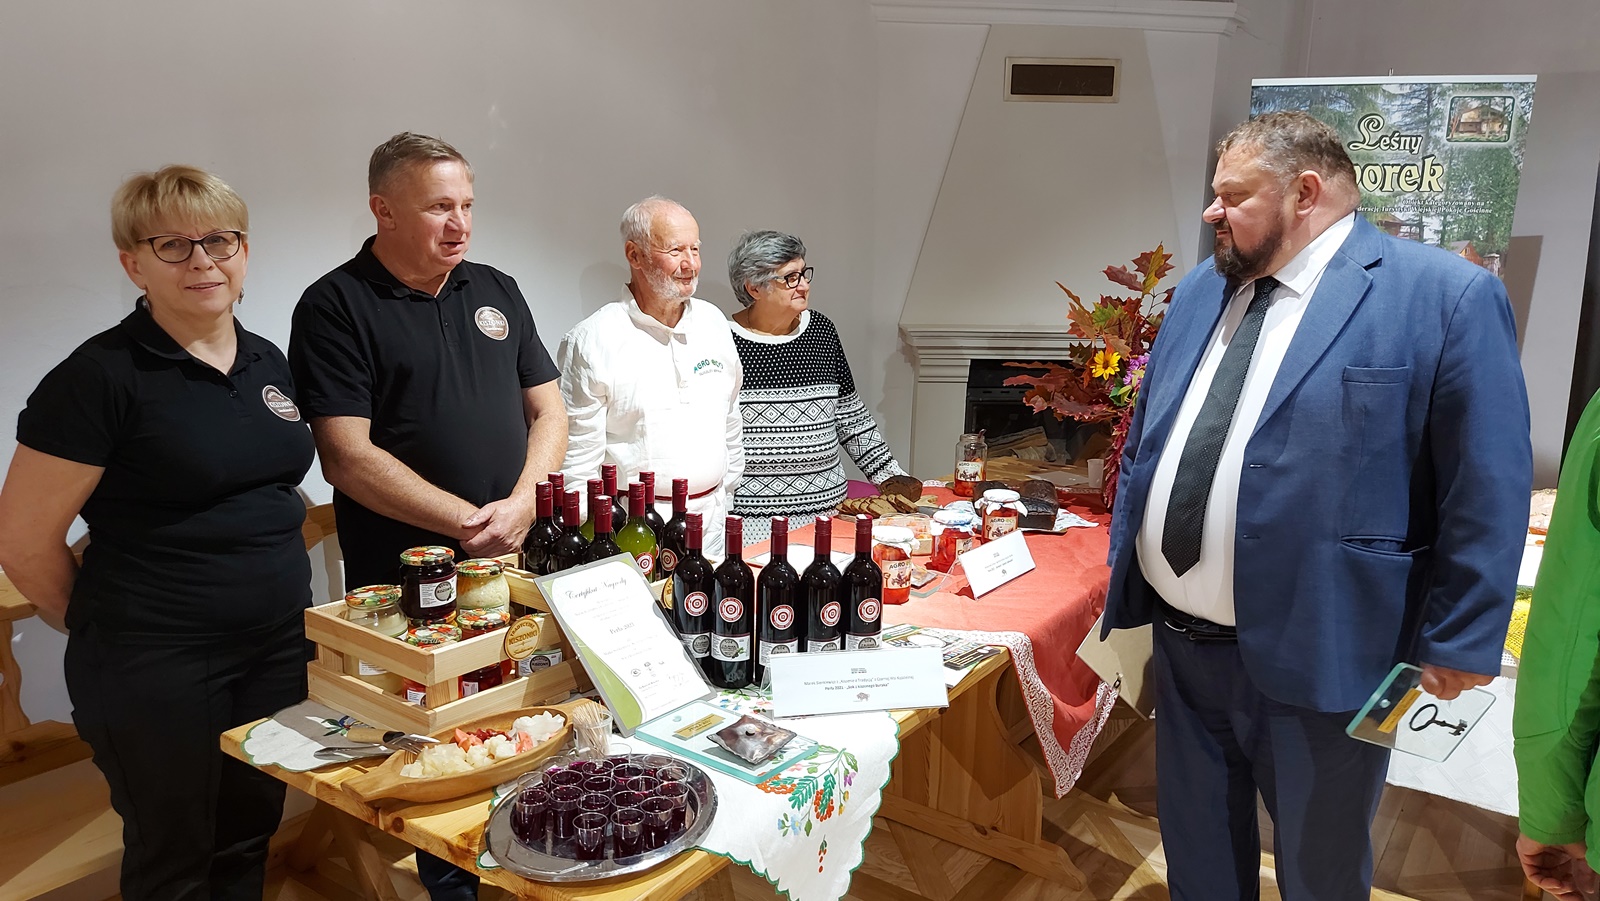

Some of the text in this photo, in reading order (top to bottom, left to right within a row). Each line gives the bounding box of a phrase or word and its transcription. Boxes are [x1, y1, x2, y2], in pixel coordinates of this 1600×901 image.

[1347, 113, 1423, 155] Leśny
[1425, 199, 1475, 207] kategoryzowany
[1357, 206, 1380, 214] derację
[694, 359, 710, 374] AGRO
[889, 562, 906, 570] AGRO
[508, 629, 539, 646] KISZONKI
